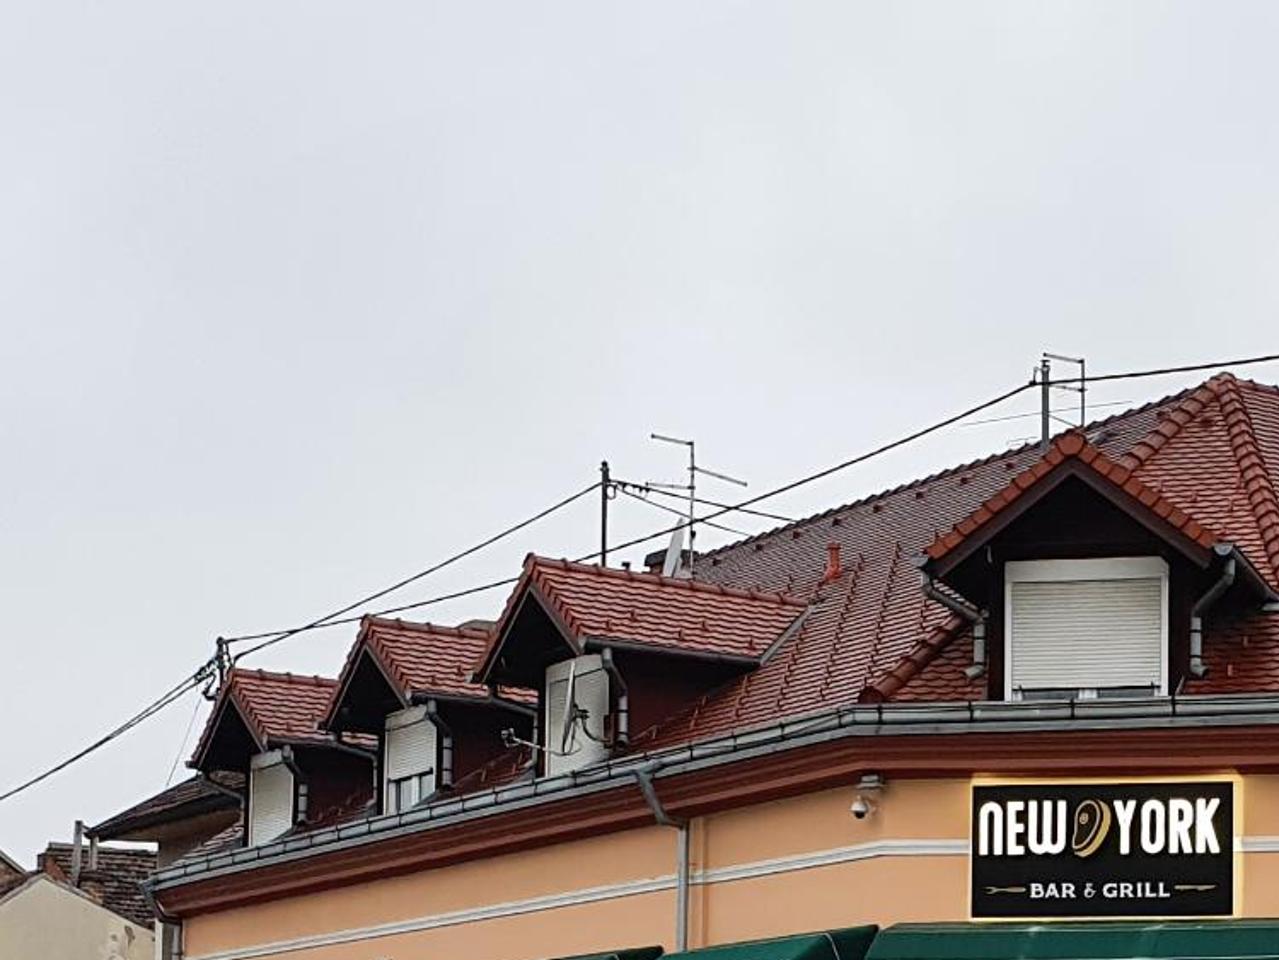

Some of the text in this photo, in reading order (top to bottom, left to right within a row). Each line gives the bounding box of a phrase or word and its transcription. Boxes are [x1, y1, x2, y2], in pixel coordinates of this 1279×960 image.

[978, 797, 1220, 856] NEW YORK
[1029, 882, 1170, 898] BAR & GRILL
